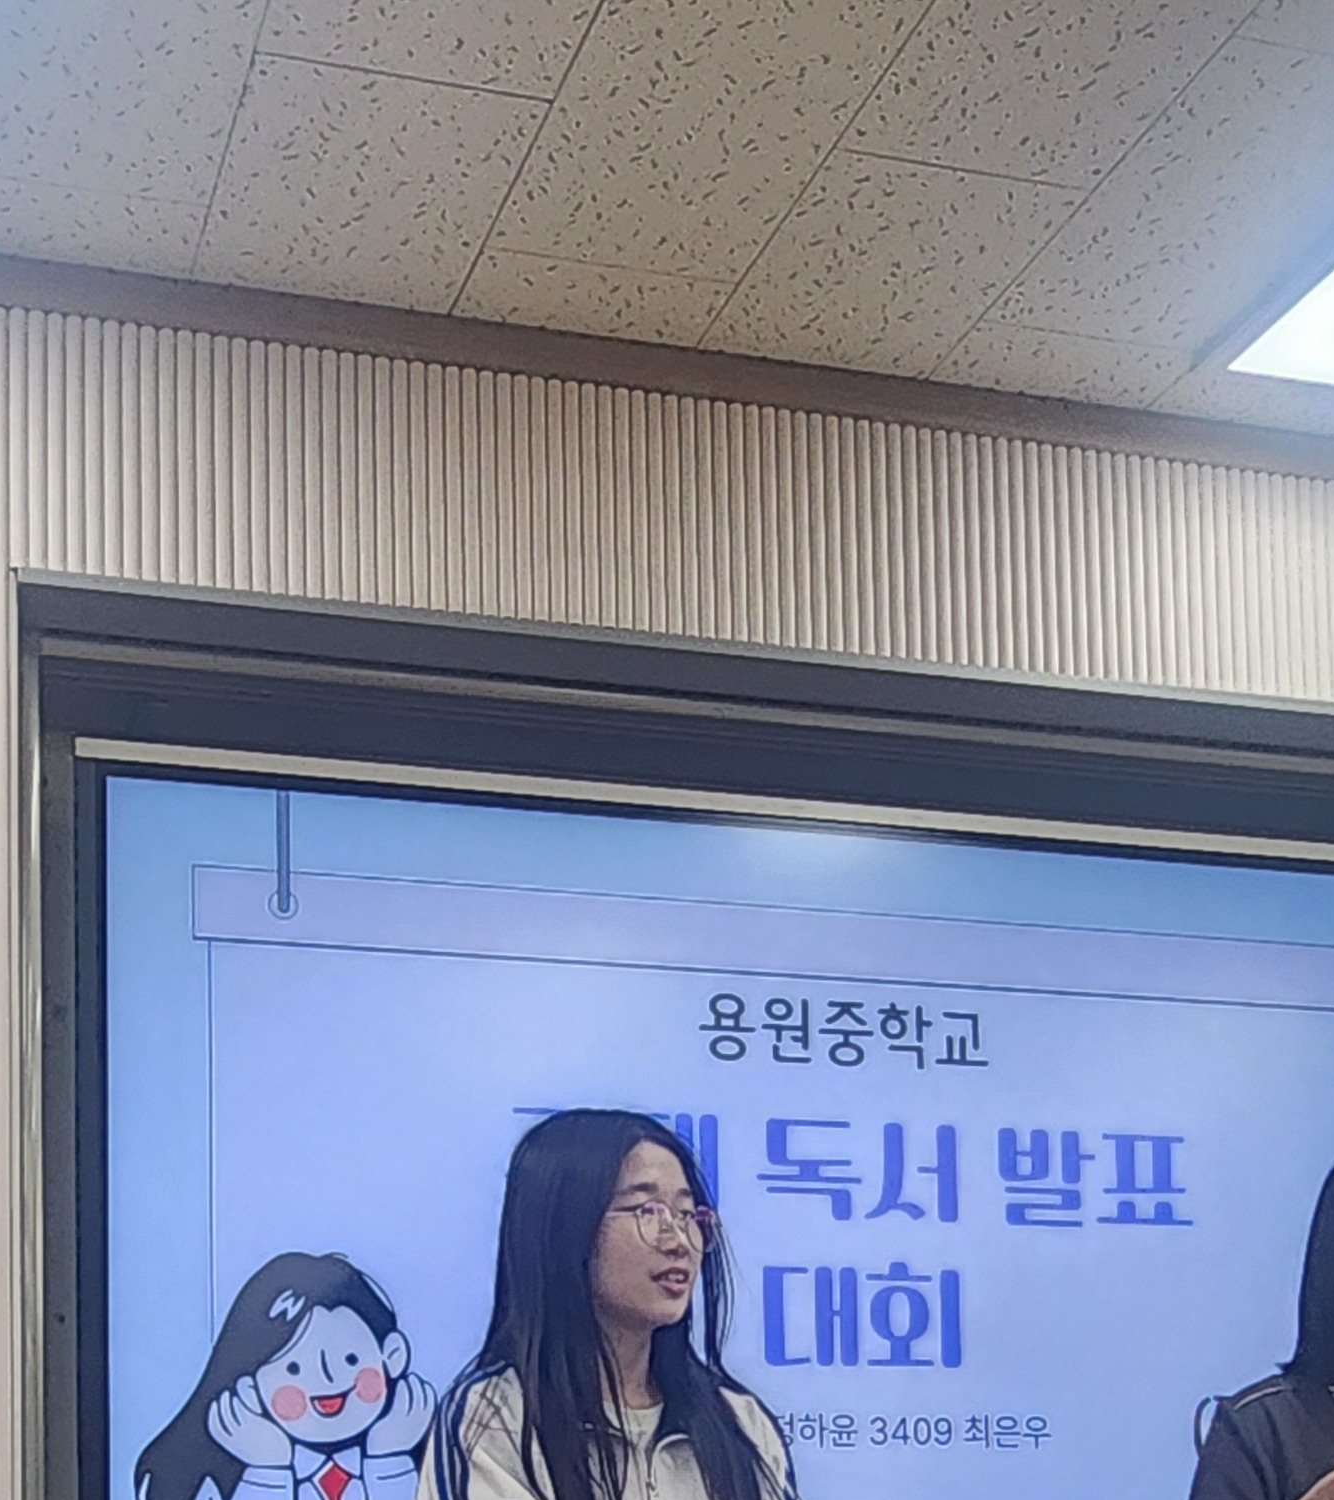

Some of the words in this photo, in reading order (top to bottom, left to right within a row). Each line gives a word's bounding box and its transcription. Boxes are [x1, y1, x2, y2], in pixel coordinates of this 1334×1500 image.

[697, 991, 990, 1070] 용원중학교
[756, 1117, 960, 1224] 독서
[997, 1126, 1194, 1228] 발표
[762, 1261, 963, 1370] 대회
[869, 1415, 953, 1447] 3409
[963, 1413, 1053, 1450] 최은우
